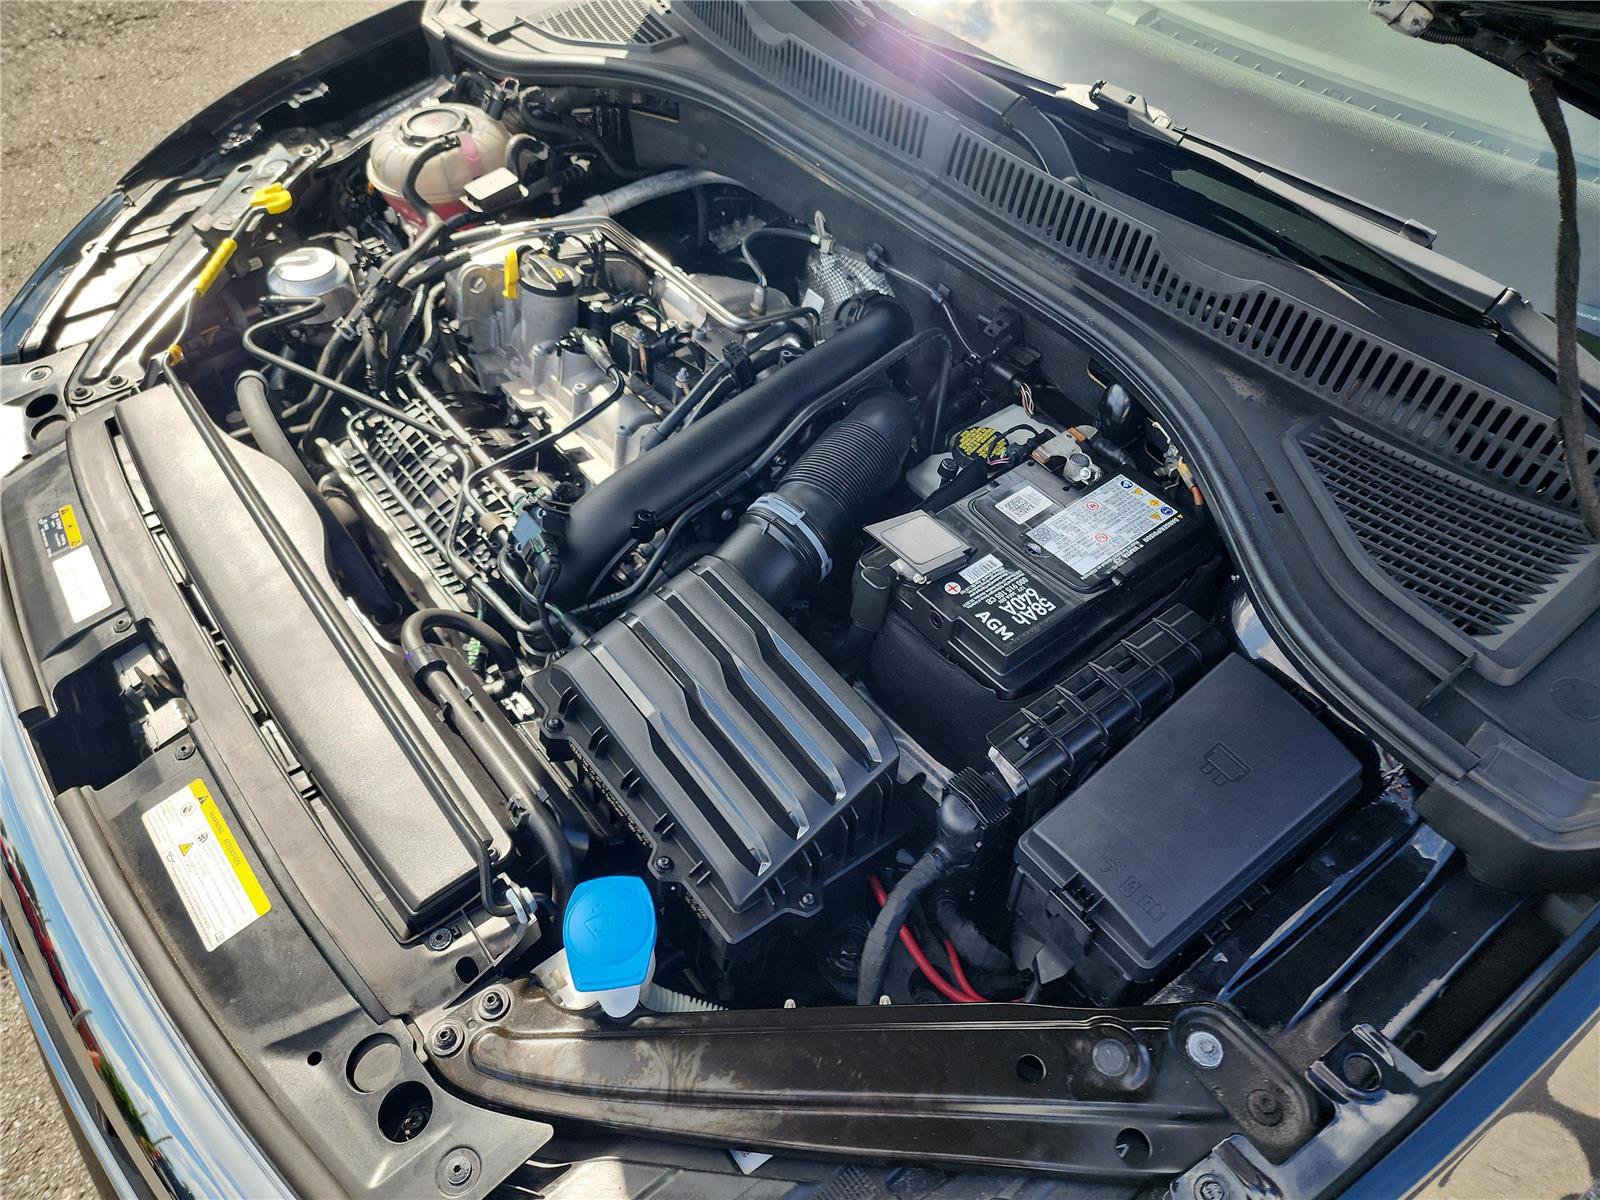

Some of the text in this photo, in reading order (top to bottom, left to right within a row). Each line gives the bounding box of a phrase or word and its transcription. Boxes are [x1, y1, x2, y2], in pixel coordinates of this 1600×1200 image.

[998, 588, 1040, 616] 640A
[1011, 598, 1057, 625] 58Ah
[974, 611, 1015, 641] AGM
[223, 838, 242, 866] ATTENTION
